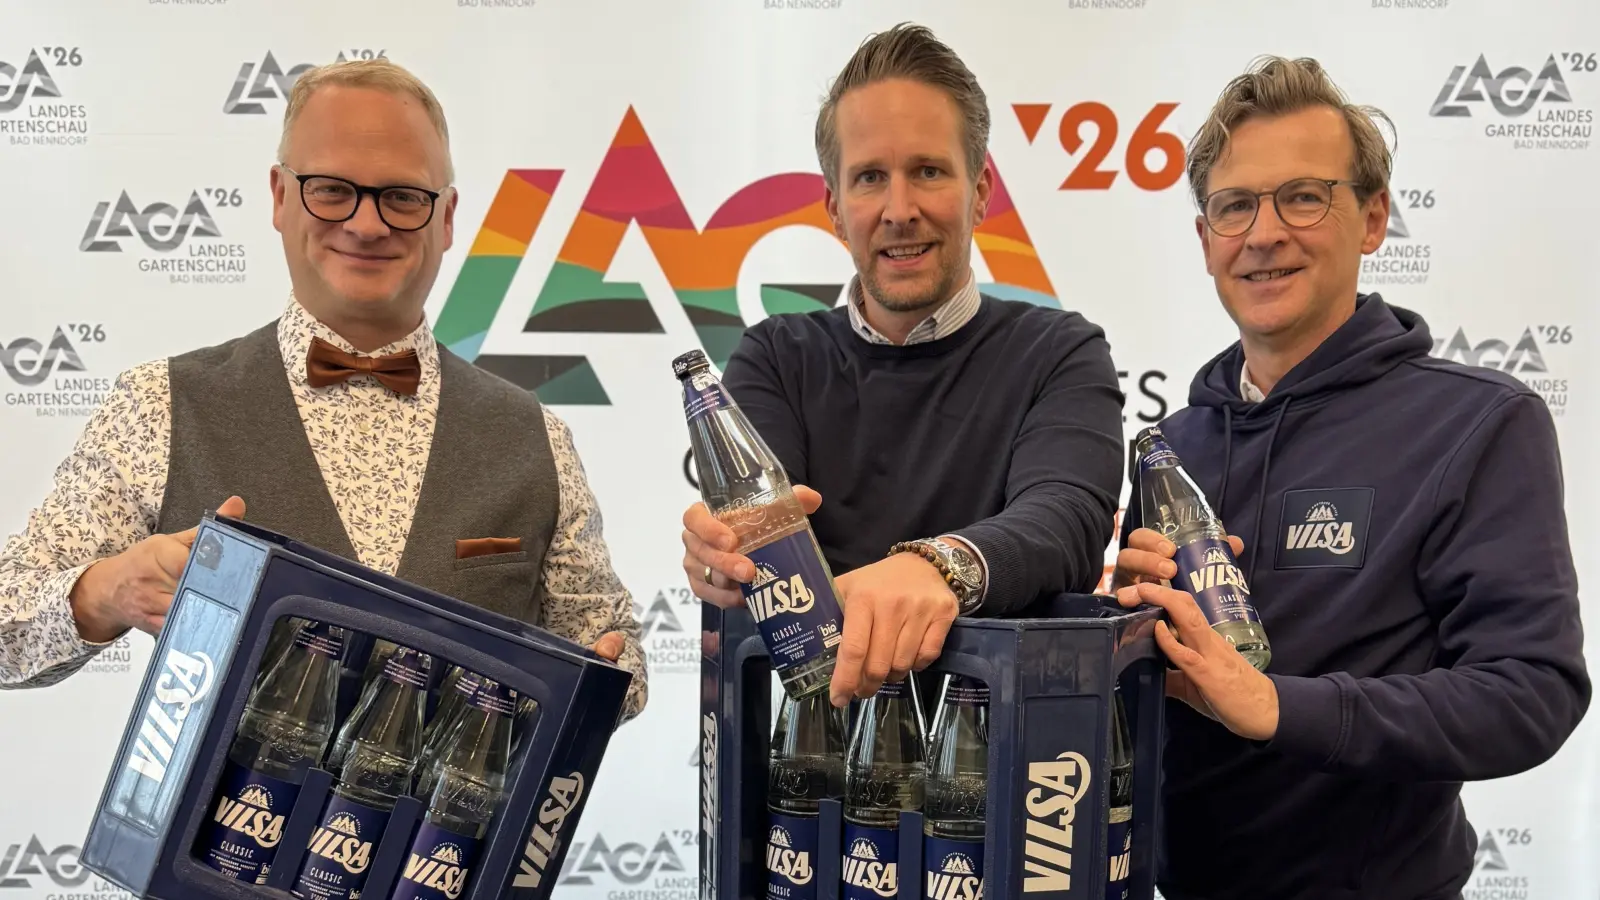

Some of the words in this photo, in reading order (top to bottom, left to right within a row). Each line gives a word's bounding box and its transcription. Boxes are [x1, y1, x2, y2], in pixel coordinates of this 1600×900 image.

[29, 105, 86, 118] LANDES
[1538, 110, 1593, 123] LANDES
[0, 120, 88, 134] RTENSCHAU
[1485, 124, 1592, 138] GARTENSCHAU
[10, 136, 30, 145] BAD
[33, 136, 88, 146] NENNDORF
[1514, 140, 1533, 149] BAD
[1536, 140, 1590, 150] NENNDORF
[189, 245, 245, 257] LANDES
[1376, 245, 1431, 258] LANDES
[139, 259, 246, 272] GARTENSCHAU
[1362, 260, 1430, 273] ENSCHAU
[170, 274, 190, 284] BAD
[192, 274, 247, 284] NENNDORF
[55, 379, 110, 391] LANDES
[1526, 380, 1568, 392] ANDES
[37, 408, 56, 417] BAD
[1286, 521, 1356, 555] VILSA
[1189, 564, 1251, 595] VILSA
[745, 573, 815, 624] VILSA
[772, 621, 803, 642] CLASSIC
[820, 623, 837, 637] bio
[126, 648, 216, 784] VILSA
[214, 796, 285, 848] VILSA
[1023, 751, 1092, 893] VILSA
[511, 771, 584, 889] VILSA
[220, 840, 254, 858] CLASSIC
[307, 825, 373, 874] VILSA
[310, 867, 343, 885] CLASSIC
[403, 853, 468, 900] VILSA
[843, 855, 899, 897] VILSA
[1476, 877, 1528, 888] LANDES
[654, 877, 699, 889] LANDE
[608, 890, 699, 900] GARTENSCHA
[1465, 889, 1528, 900] ENSCHAU
